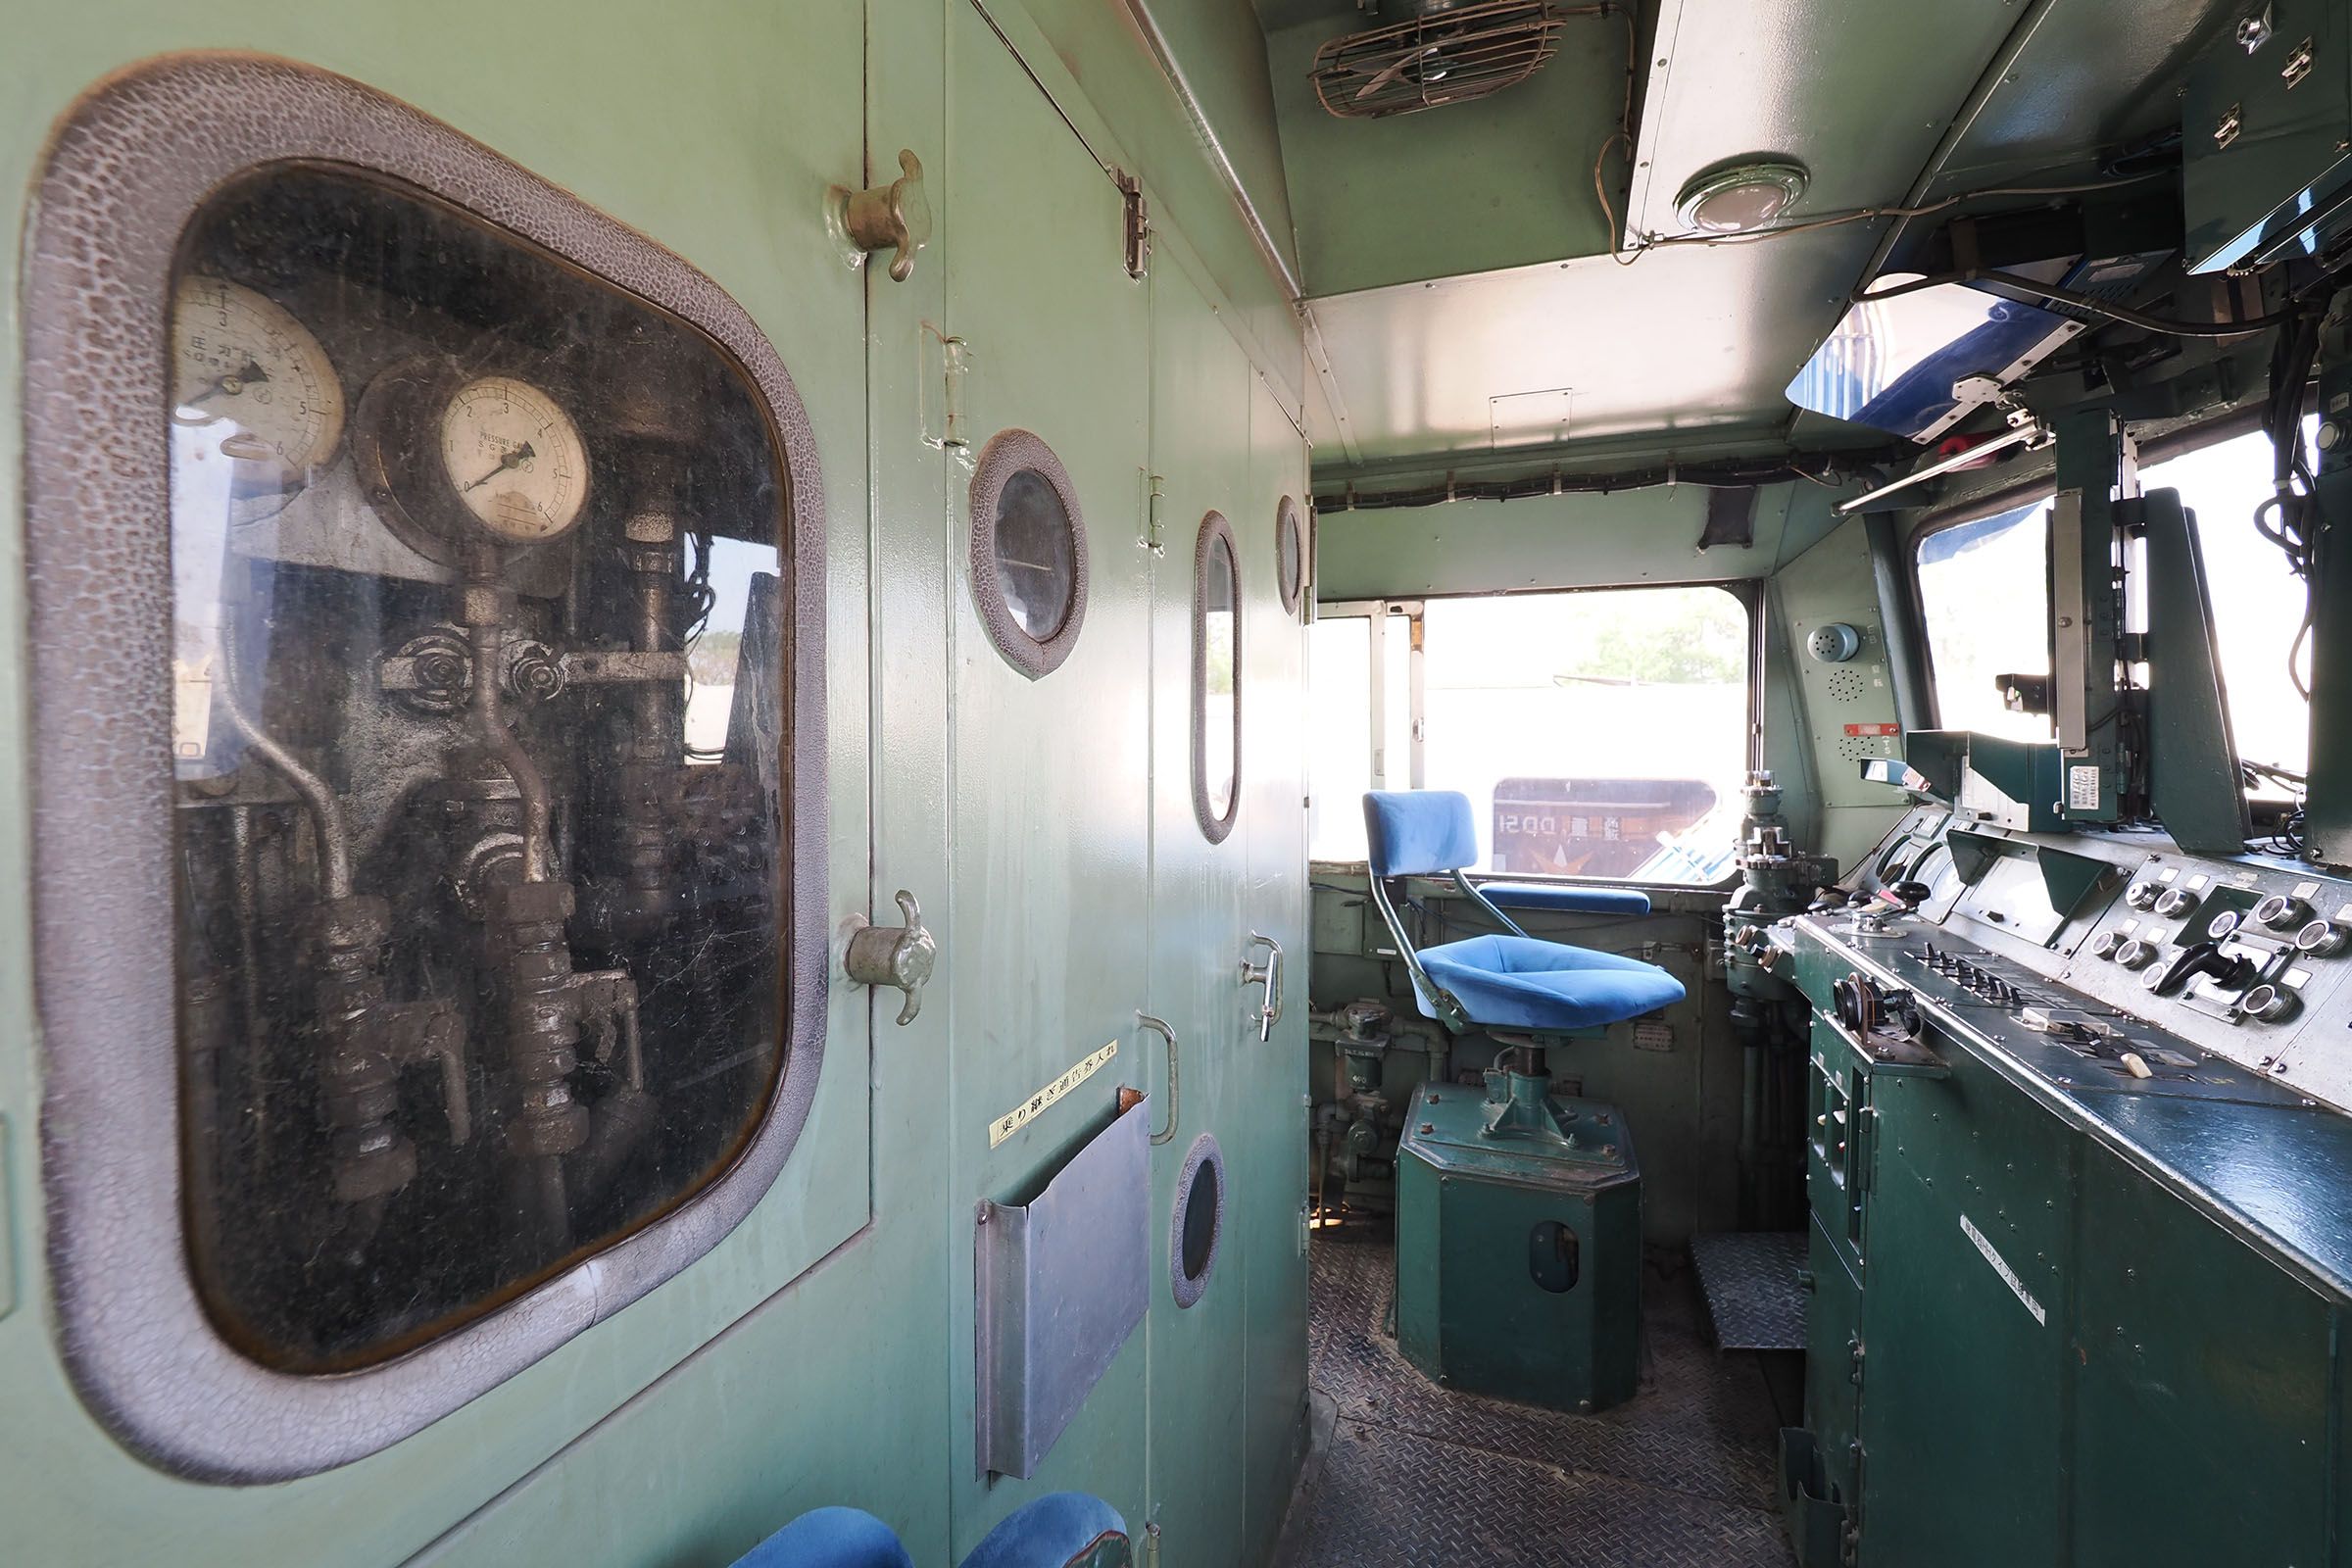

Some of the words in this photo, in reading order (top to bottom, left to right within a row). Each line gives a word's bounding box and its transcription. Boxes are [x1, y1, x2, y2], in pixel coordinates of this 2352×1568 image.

[299, 401, 307, 415] 5
[466, 406, 472, 417] 2
[503, 403, 510, 414] 3
[536, 428, 543, 439] 4
[553, 468, 558, 478] 5
[537, 502, 543, 512] 6
[999, 1046, 1115, 1136] 乗り継ぎ通告券入れ
